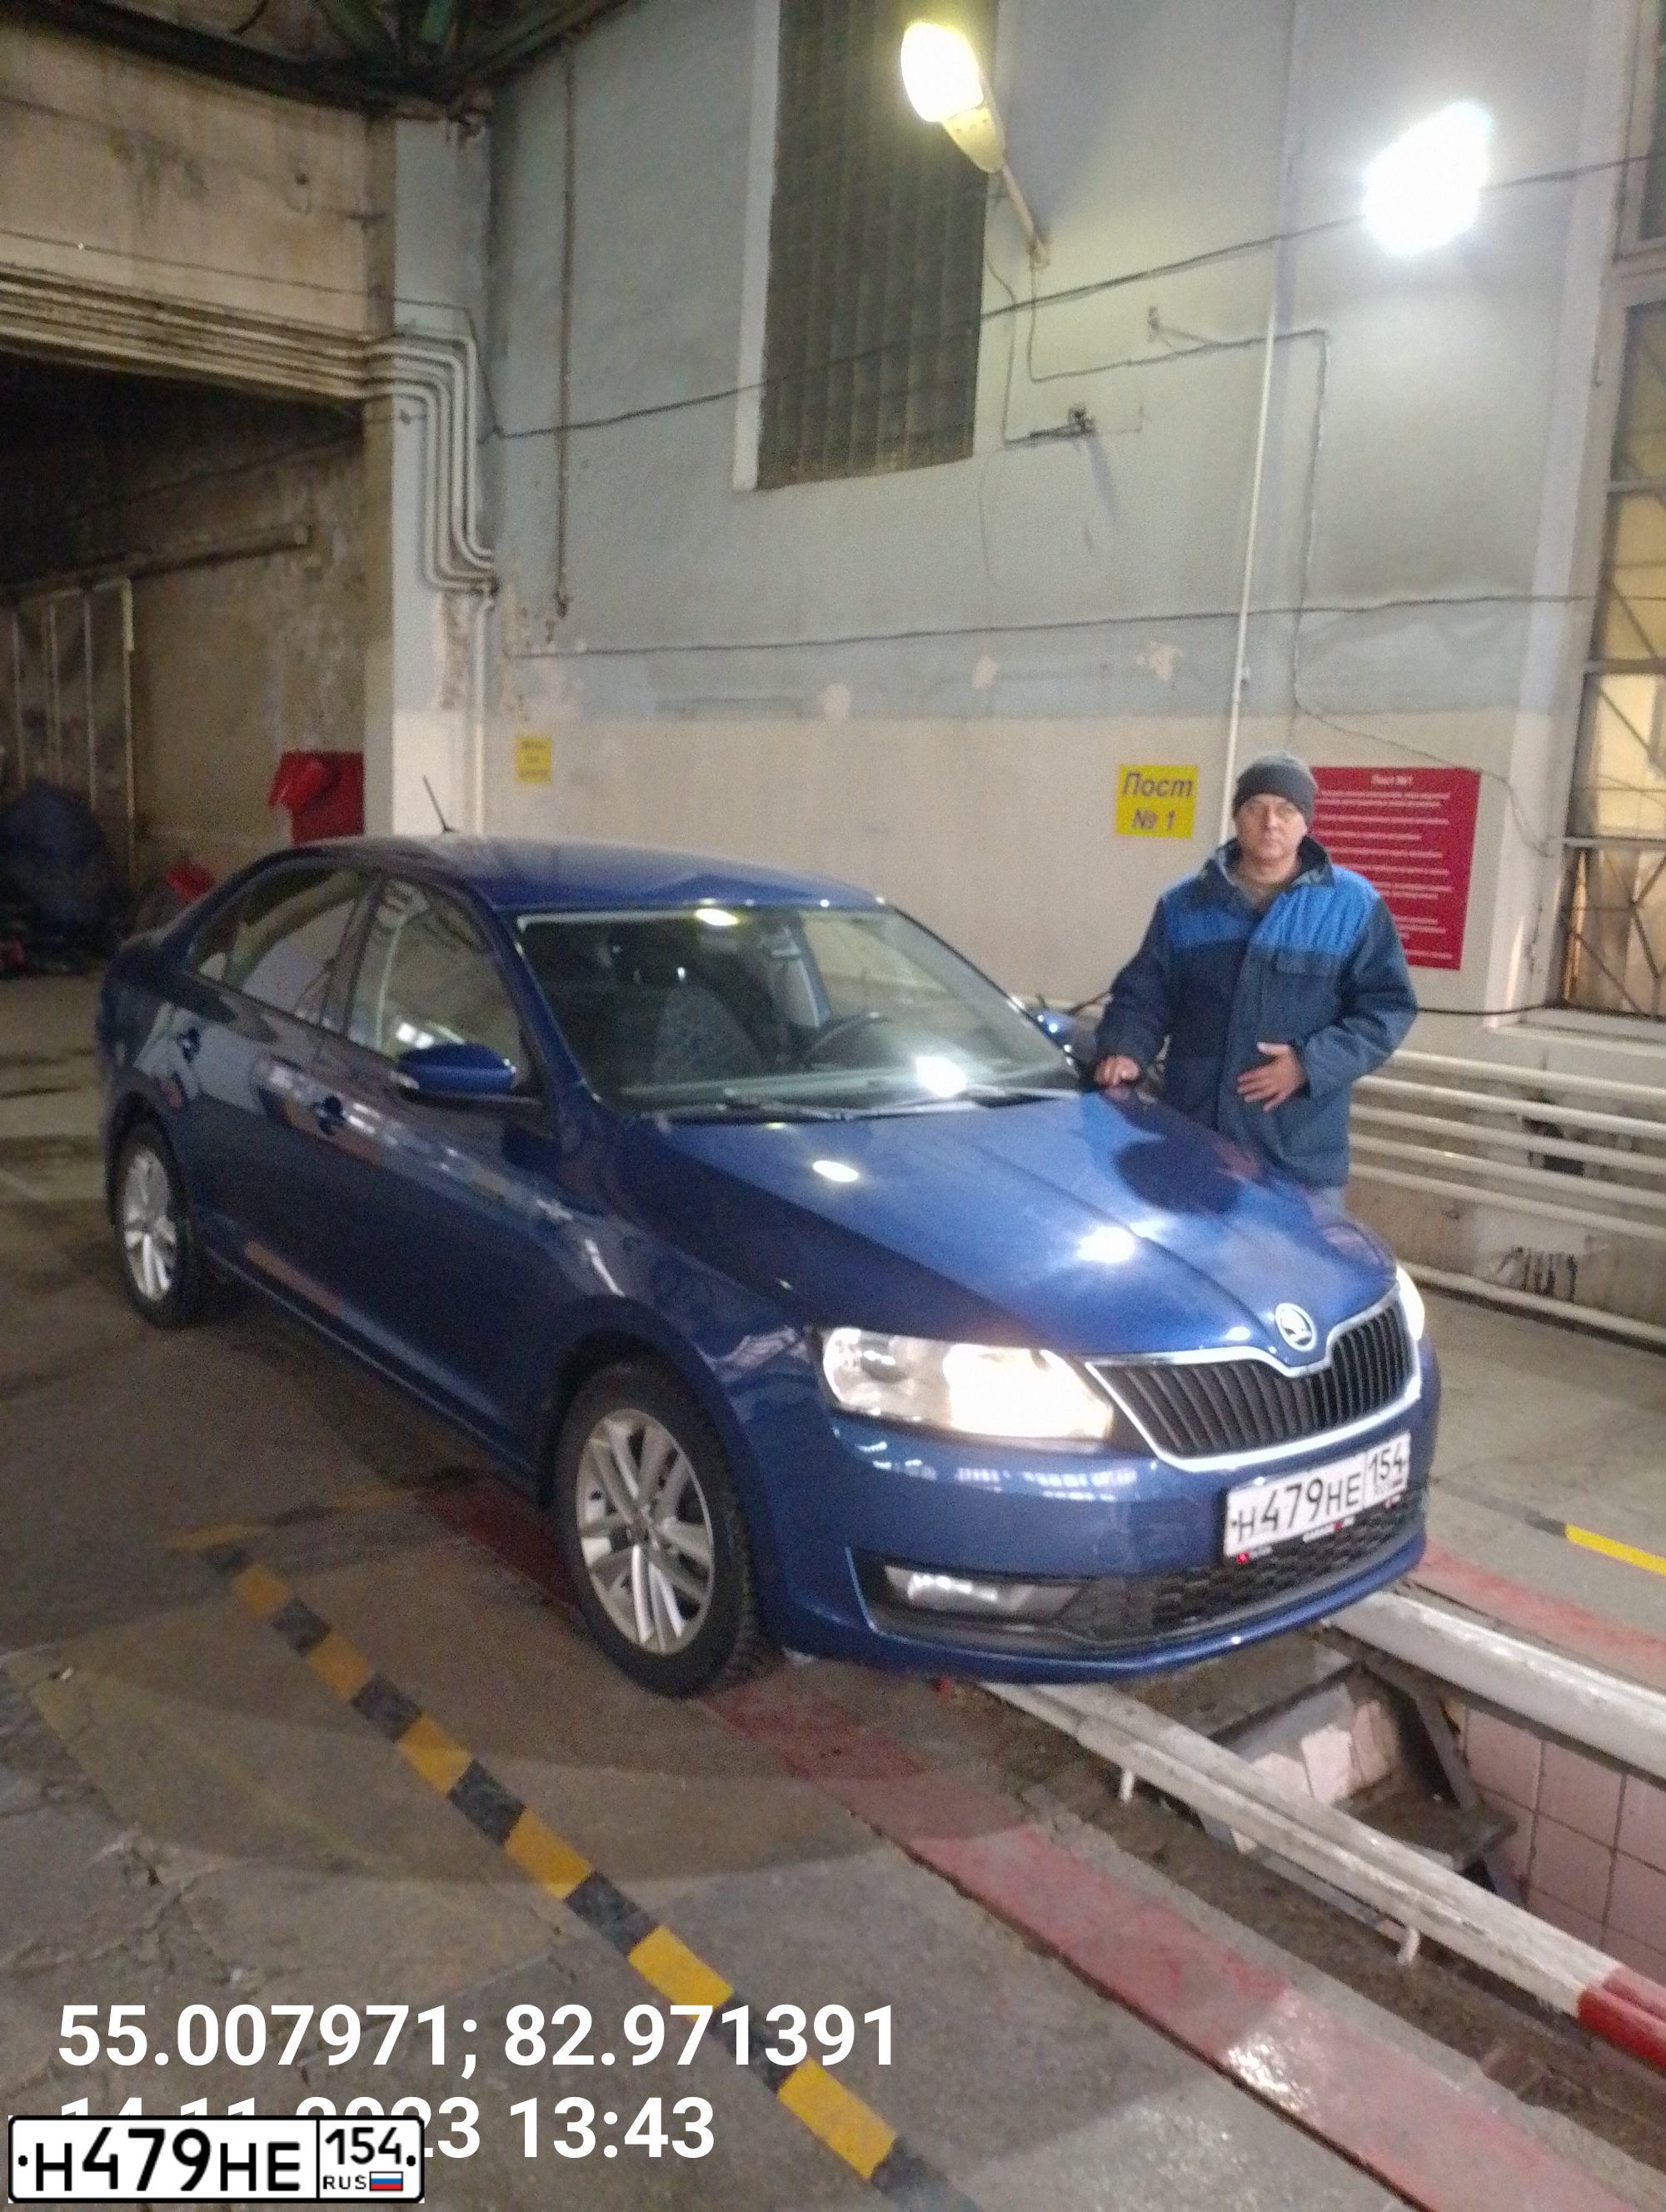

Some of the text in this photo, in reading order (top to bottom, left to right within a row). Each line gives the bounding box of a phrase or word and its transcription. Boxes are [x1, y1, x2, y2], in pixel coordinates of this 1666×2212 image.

[1122, 771, 1193, 797] Пост
[1132, 809, 1175, 830] № 1
[1238, 1472, 1361, 1542] Н479НЕ
[1369, 1442, 1404, 1483] 154
